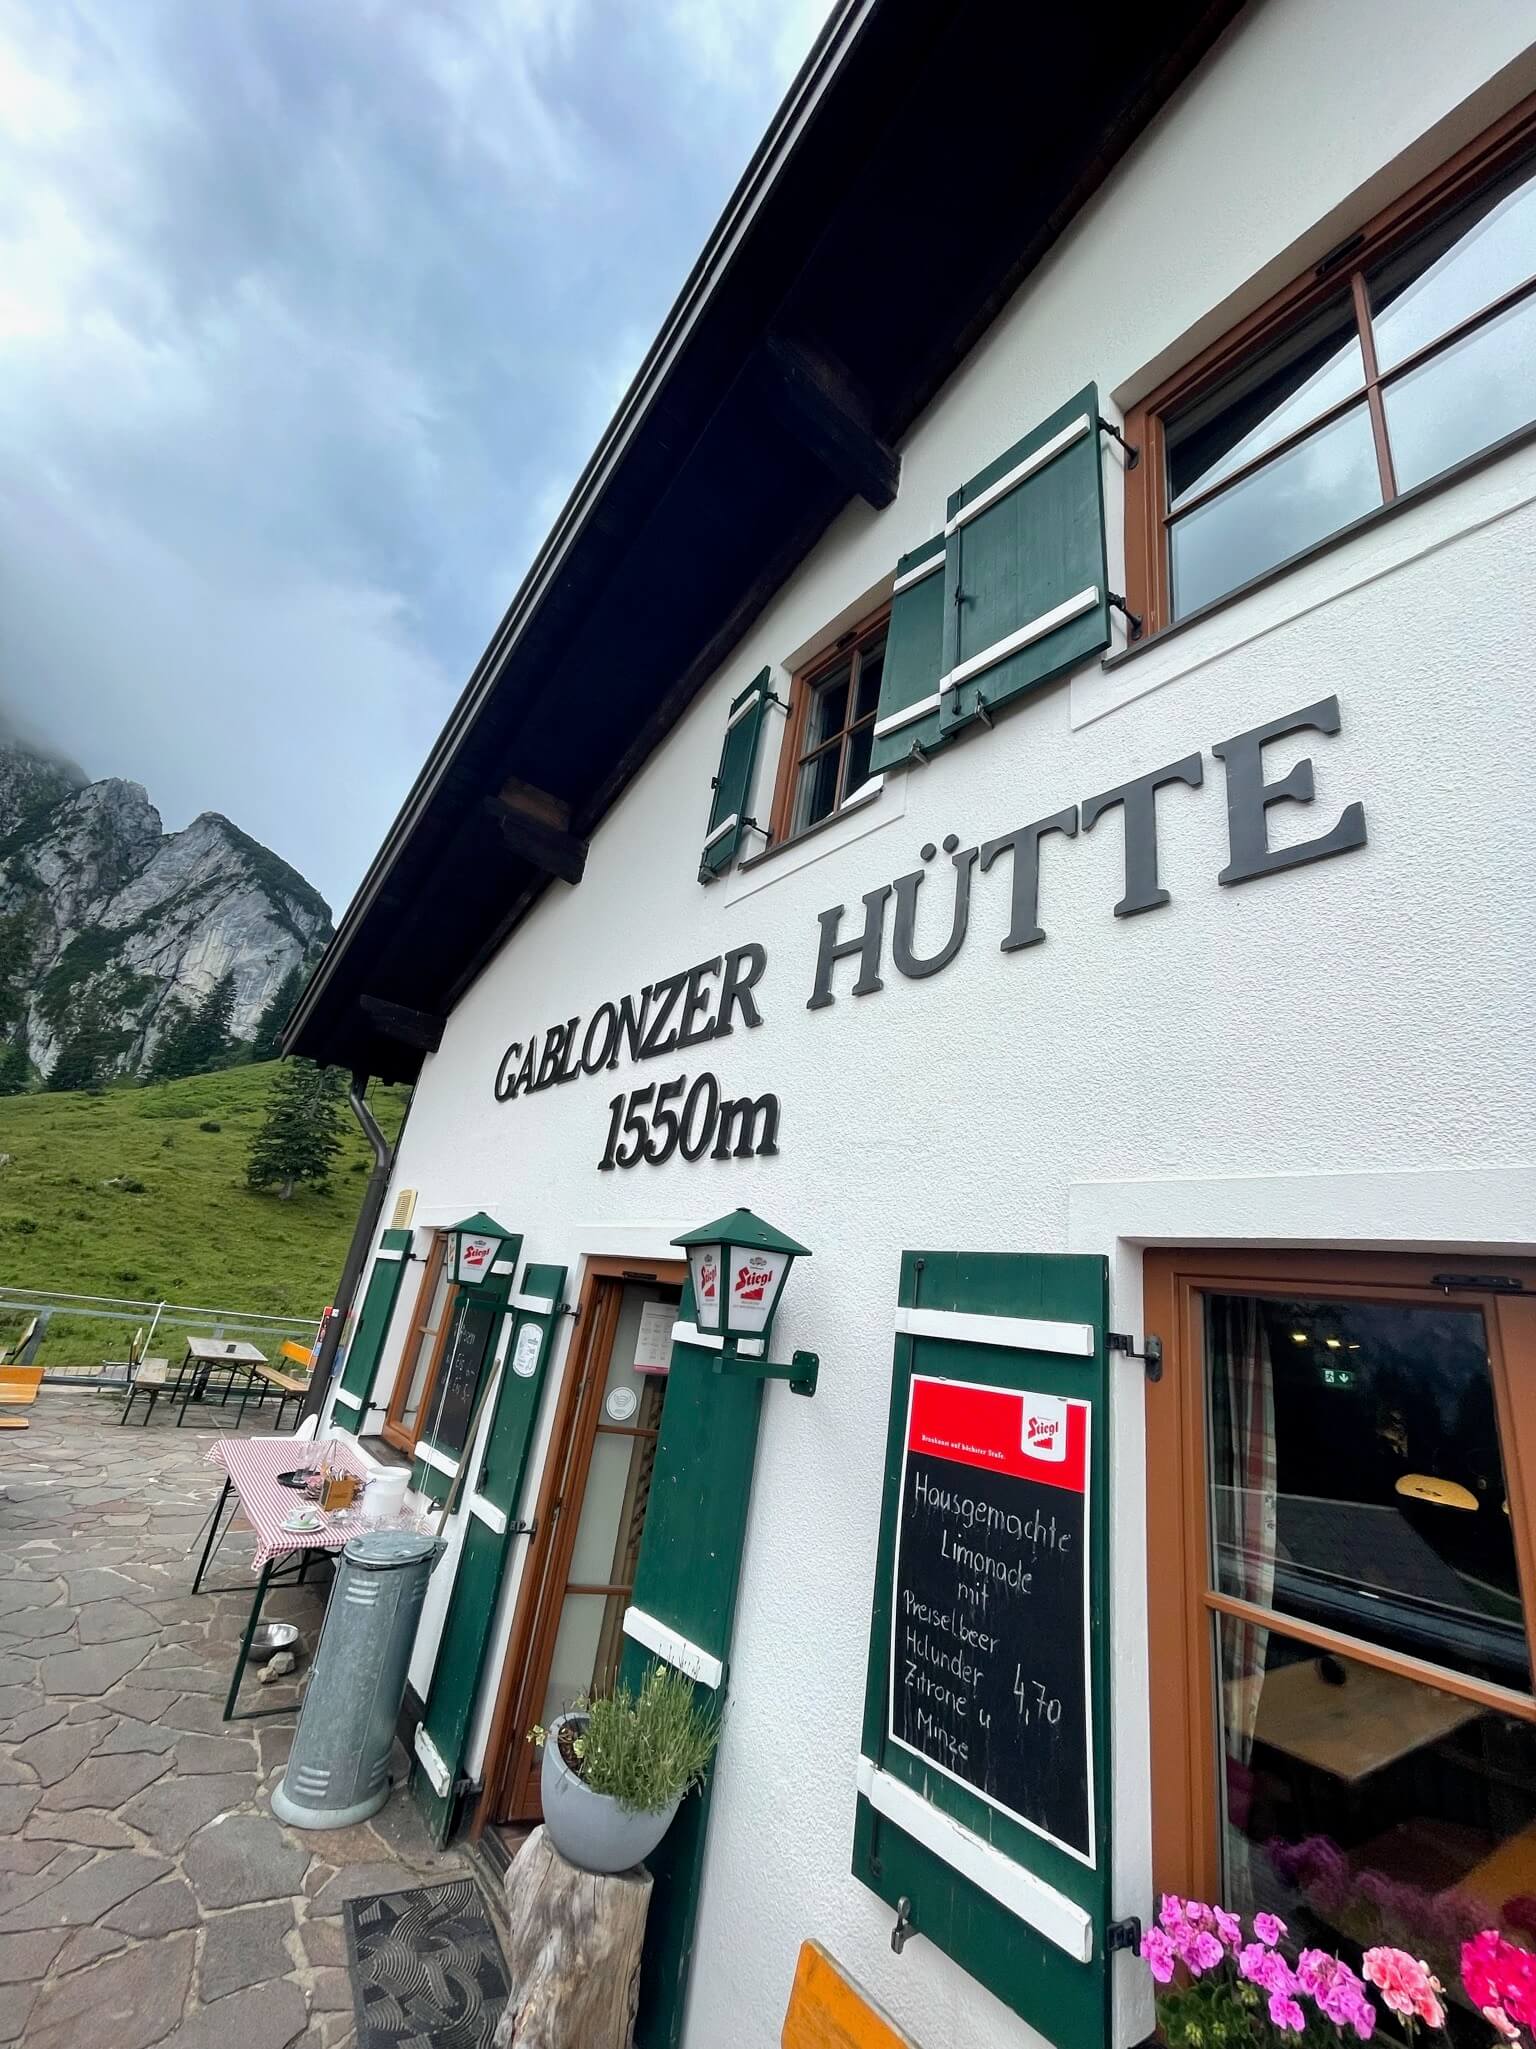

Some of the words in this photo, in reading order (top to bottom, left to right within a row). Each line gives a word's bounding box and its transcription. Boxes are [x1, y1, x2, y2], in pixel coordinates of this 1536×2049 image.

[495, 943, 768, 1103] GABLONZER
[806, 694, 1367, 1009] HÜTTE
[597, 1072, 780, 1171] 1550m
[735, 1266, 773, 1292] Stiegl
[1028, 1416, 1059, 1439] Stiegl
[914, 1472, 1072, 1552] Hausgemachte
[941, 1529, 1033, 1594] Limonade
[903, 1589, 1000, 1653] Preiselbeer
[957, 1581, 989, 1611] mit
[905, 1660, 968, 1716] Zitrone
[906, 1626, 984, 1688] Holunder
[1013, 1663, 1062, 1725] 4,70
[917, 1708, 969, 1761] Minze
